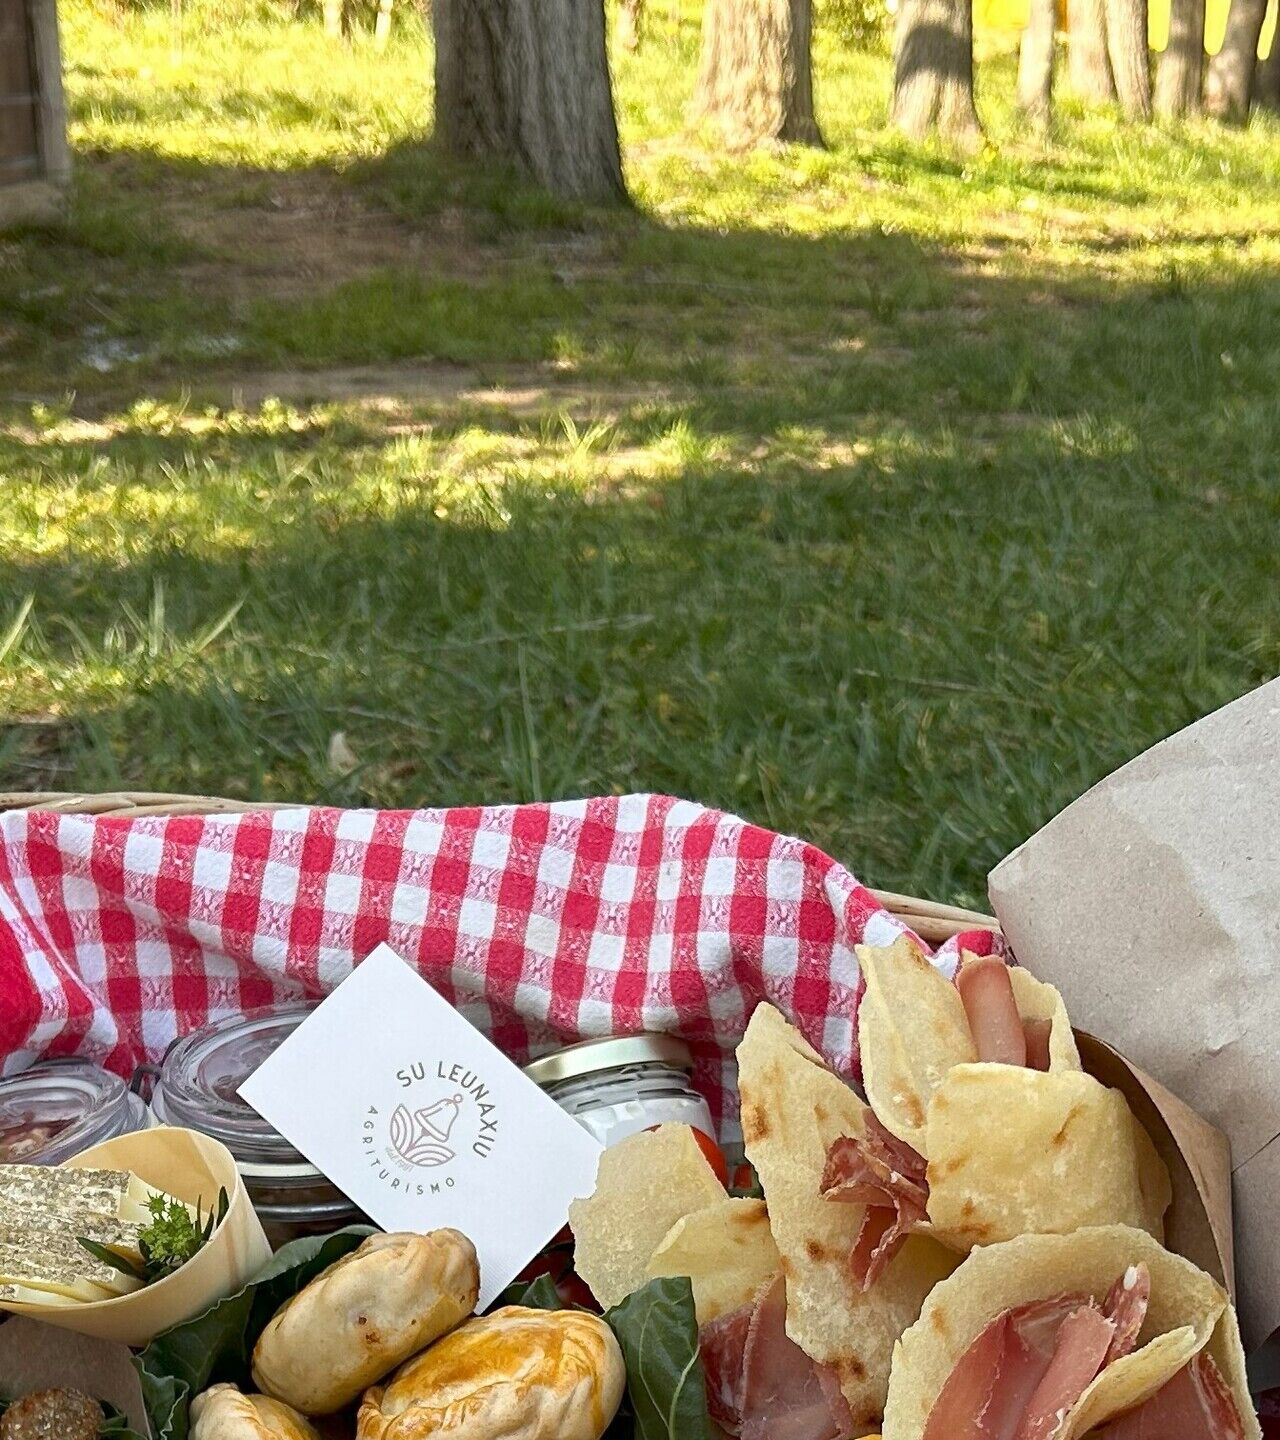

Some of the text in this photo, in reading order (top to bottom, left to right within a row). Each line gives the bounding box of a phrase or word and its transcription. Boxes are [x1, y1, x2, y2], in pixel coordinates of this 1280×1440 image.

[361, 1104, 456, 1196] AGRITURISMO
[396, 1060, 499, 1158] SU LEUNAXIU
